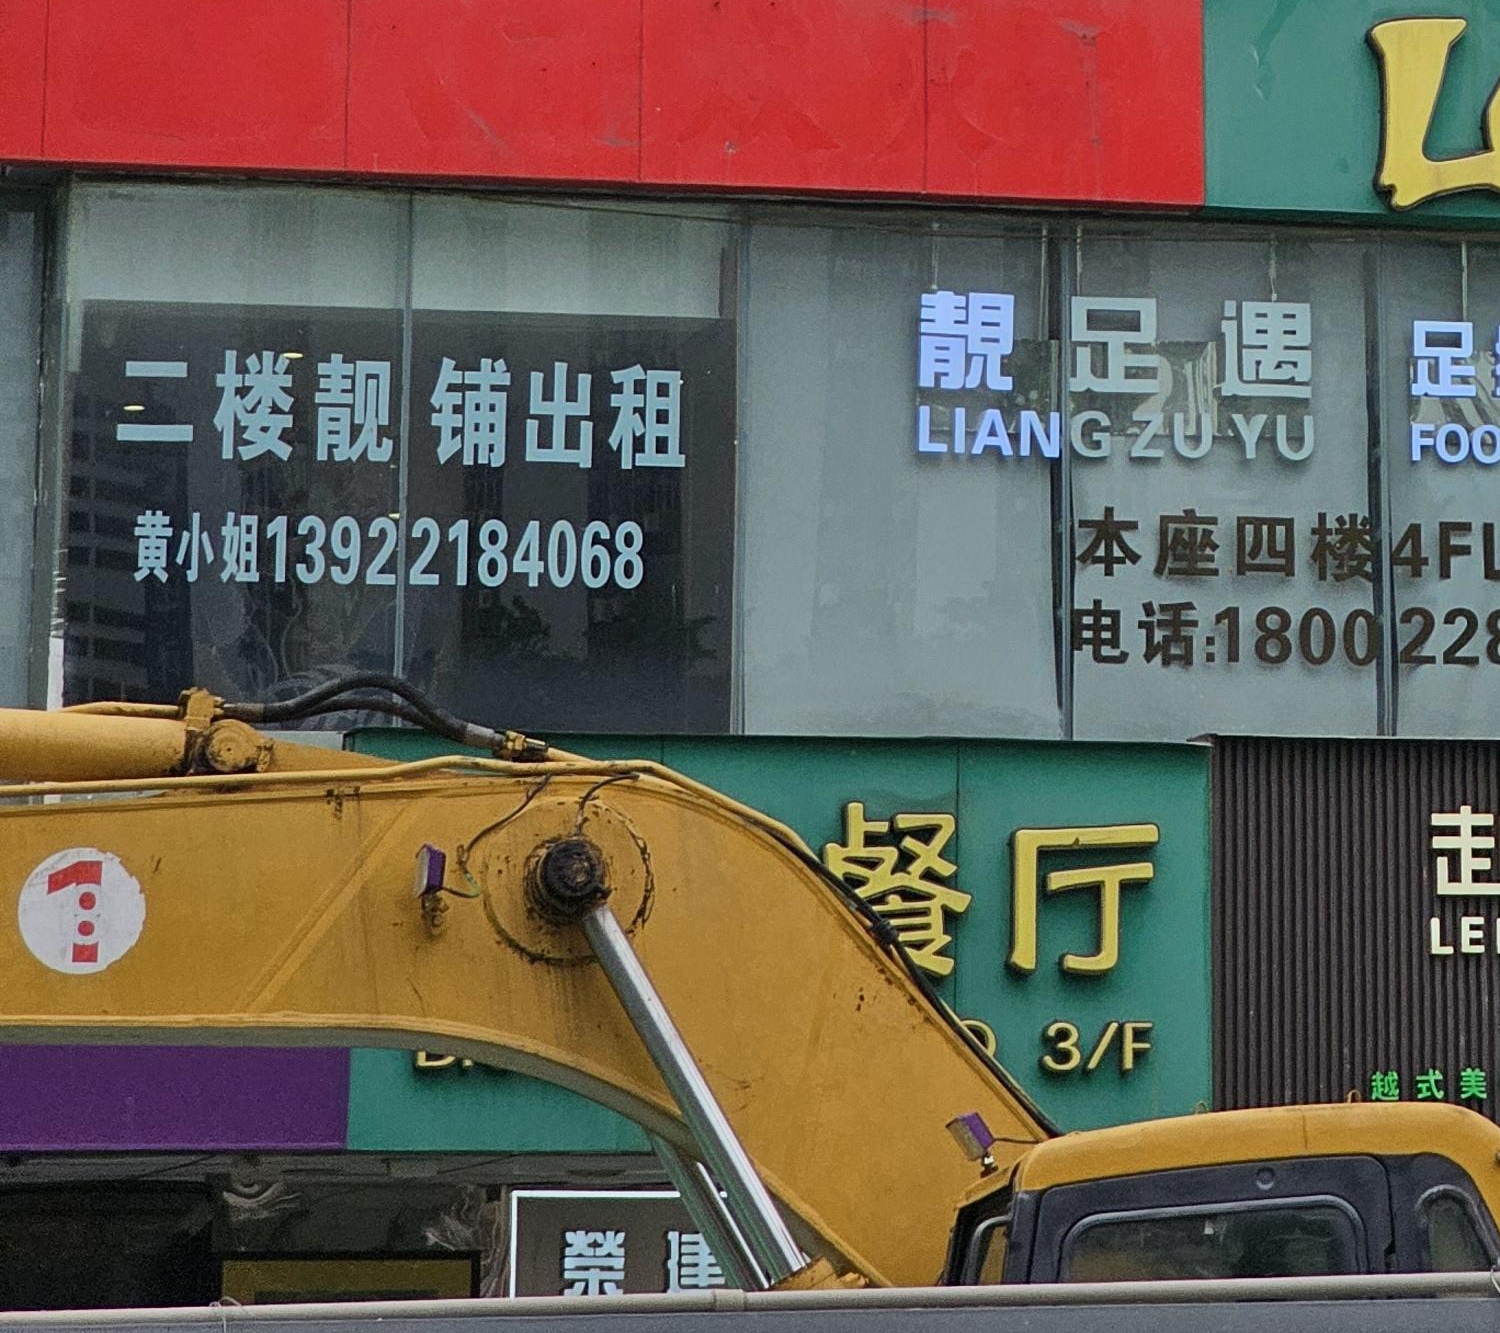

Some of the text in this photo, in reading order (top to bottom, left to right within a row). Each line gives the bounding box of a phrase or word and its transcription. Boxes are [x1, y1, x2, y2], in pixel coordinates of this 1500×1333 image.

[116, 349, 686, 471] 二楼靓铺出租
[133, 510, 644, 590] 黄小姐13922184068
[822, 800, 1161, 977] 餐厅
[1042, 1021, 1153, 1071] 3/F
